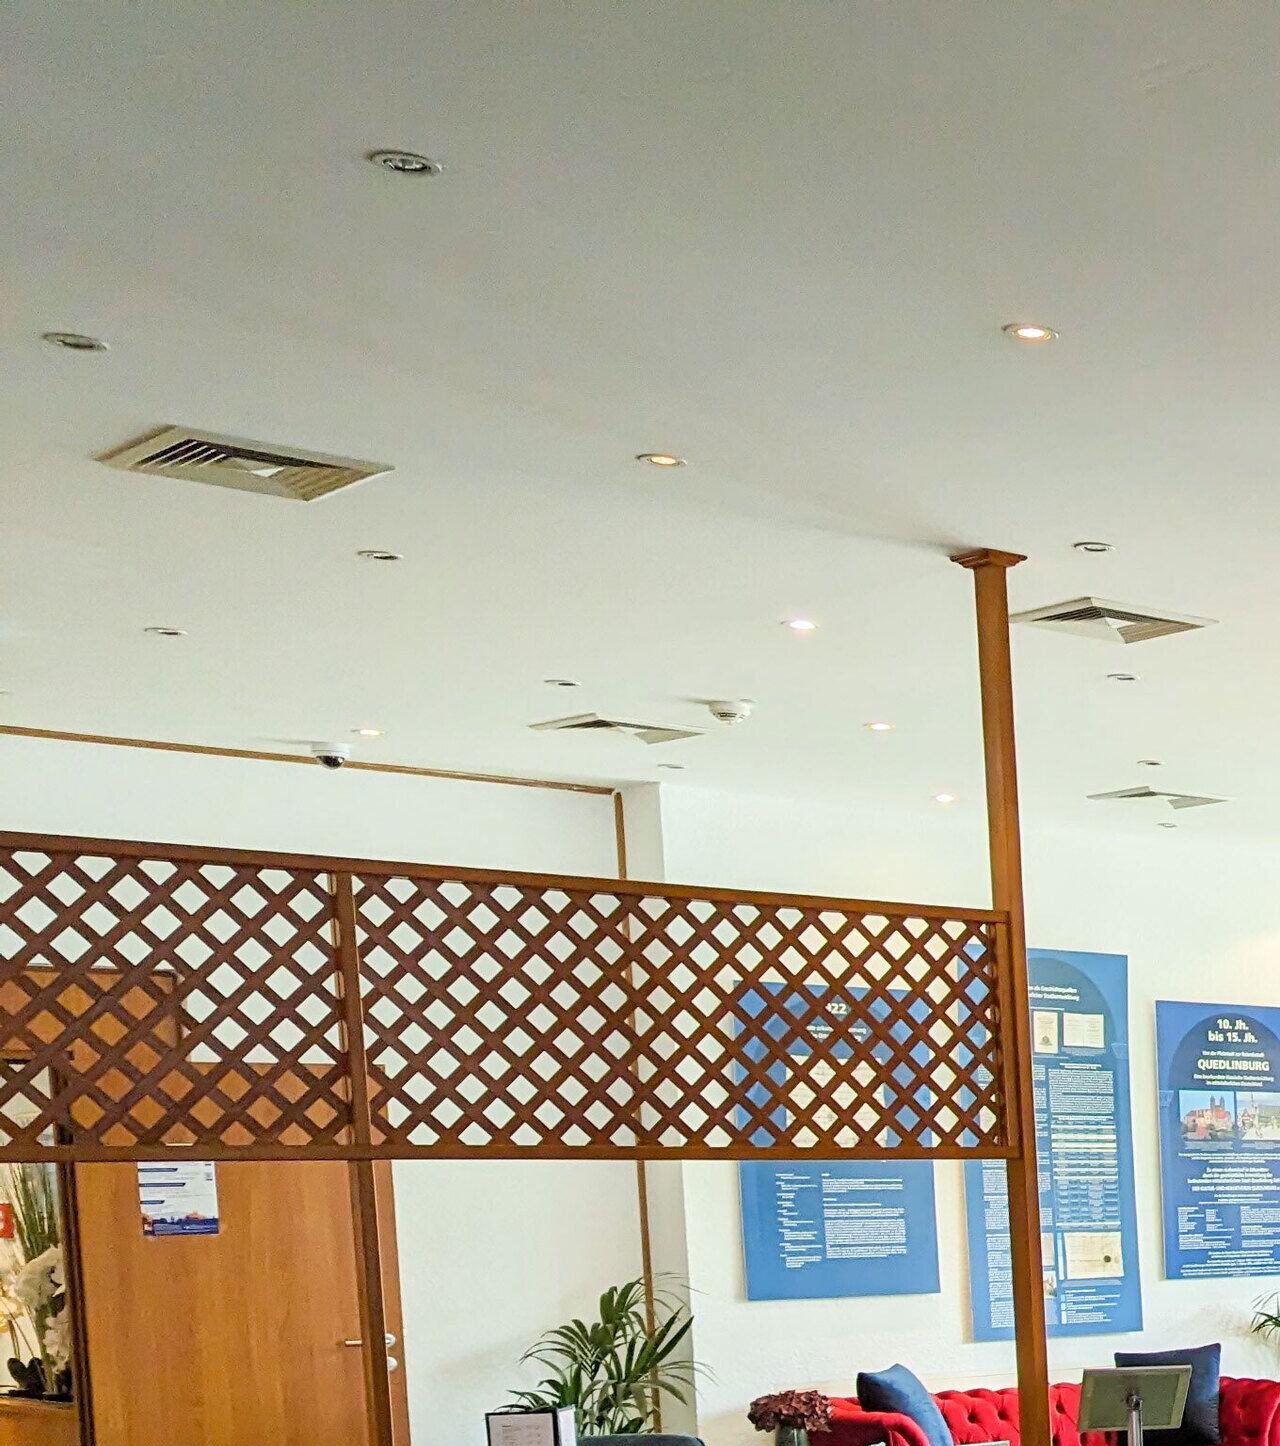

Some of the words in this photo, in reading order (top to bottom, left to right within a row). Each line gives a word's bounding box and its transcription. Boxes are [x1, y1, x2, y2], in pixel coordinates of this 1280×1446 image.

[1217, 1019, 1233, 1029] 10.
[1235, 1019, 1249, 1030] Jh.
[1208, 1031, 1224, 1042] bis
[1226, 1031, 1242, 1042] 15.
[1243, 1032, 1258, 1043] Jh.
[1197, 1059, 1270, 1071] QUEDLINBURG
